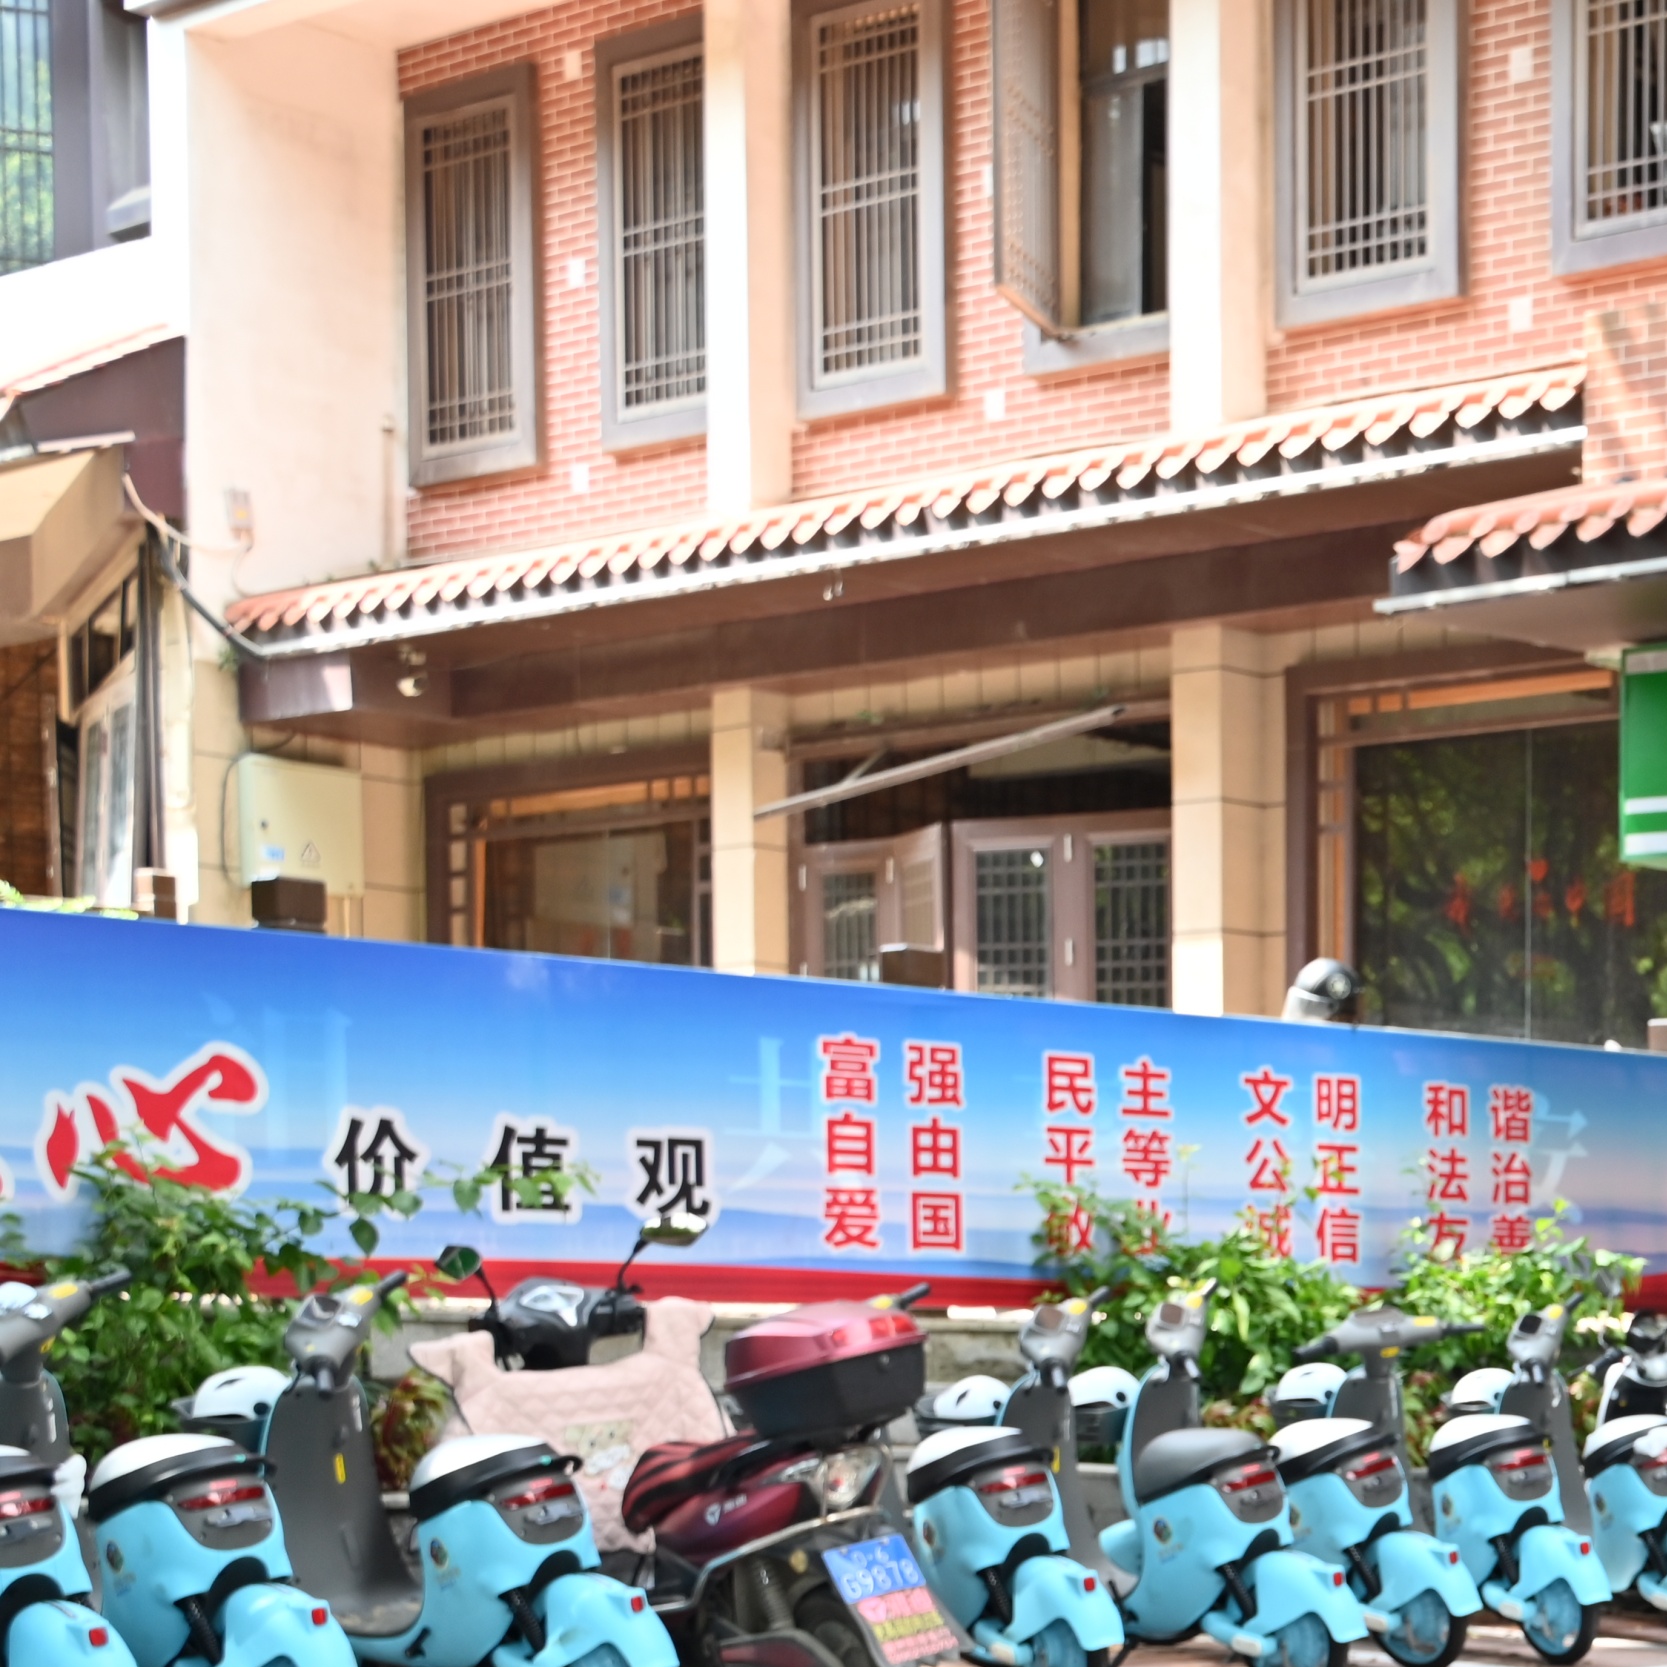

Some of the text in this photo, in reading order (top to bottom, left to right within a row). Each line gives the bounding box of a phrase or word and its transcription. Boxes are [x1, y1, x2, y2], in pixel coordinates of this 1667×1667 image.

[822, 1038, 1532, 1143] 富强 民主 文明 和谐
[335, 1118, 713, 1218] 价值观
[826, 1113, 1532, 1206] 自由 平等 公正 法治
[824, 1188, 962, 1251] 爱国
